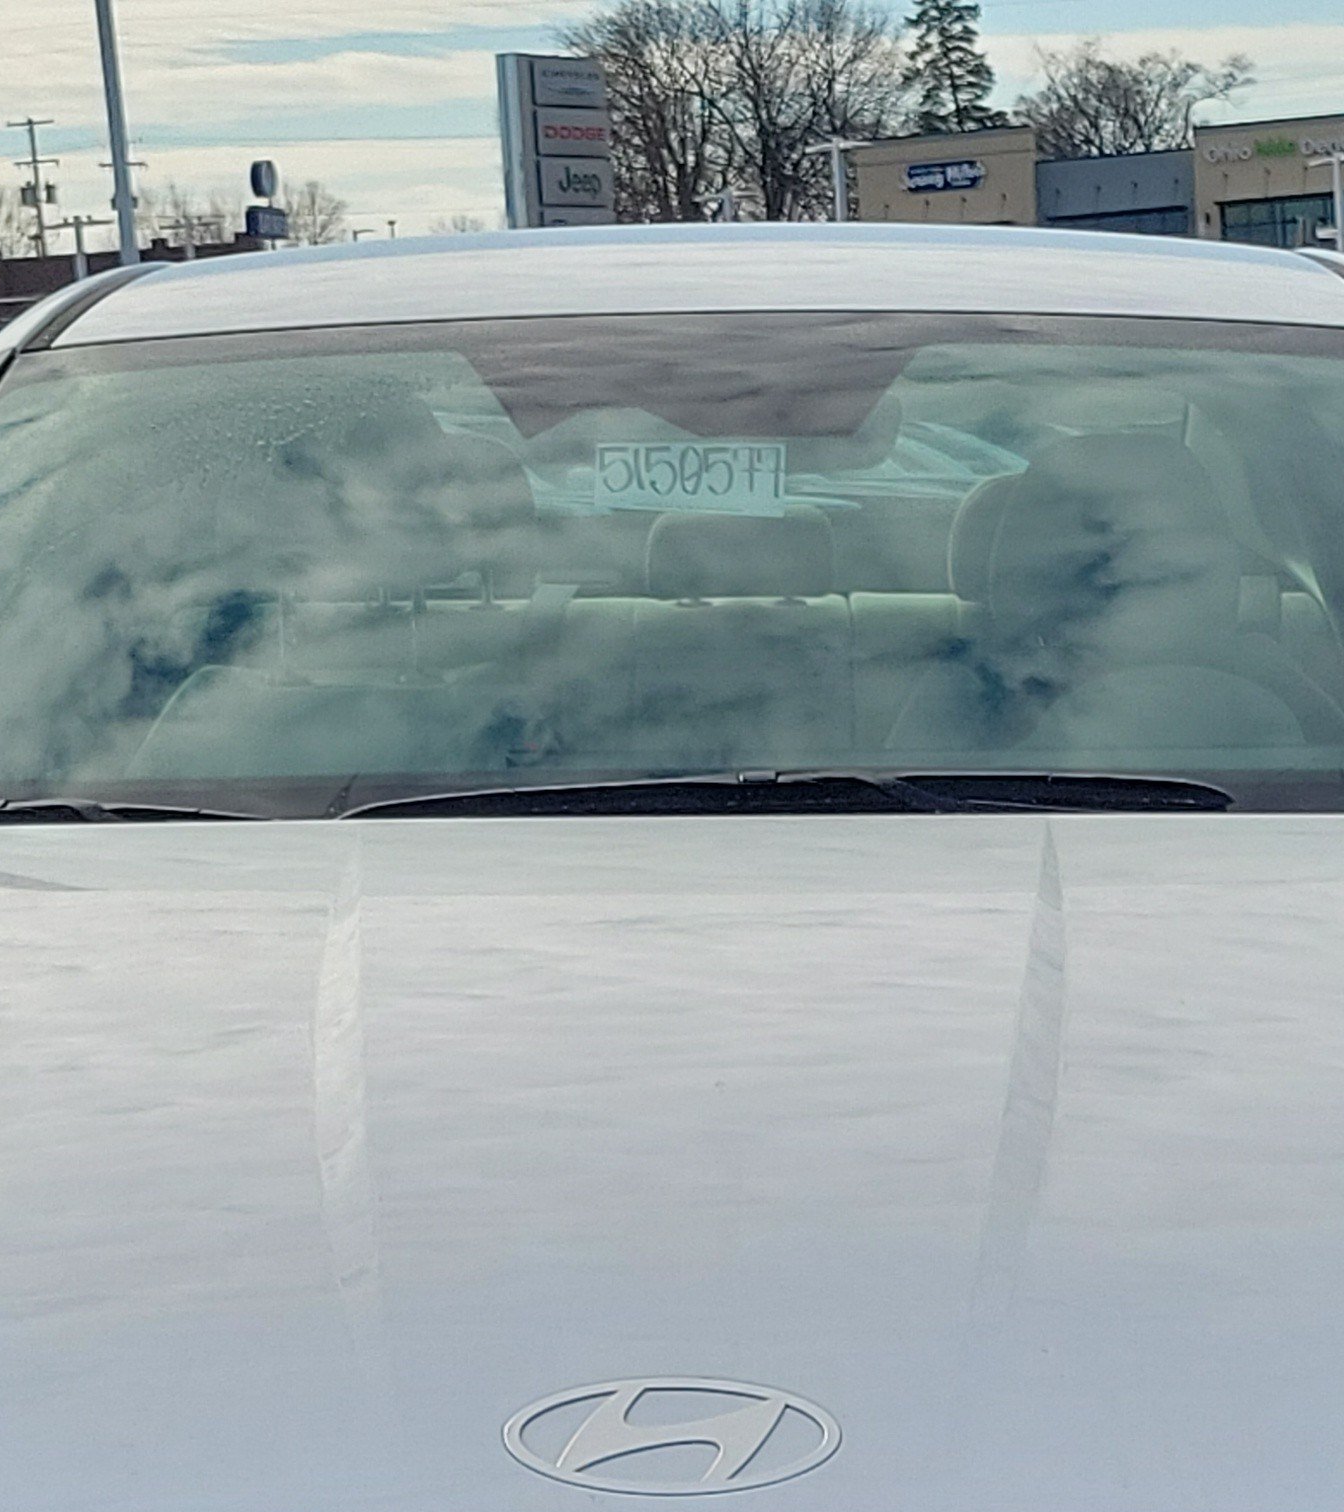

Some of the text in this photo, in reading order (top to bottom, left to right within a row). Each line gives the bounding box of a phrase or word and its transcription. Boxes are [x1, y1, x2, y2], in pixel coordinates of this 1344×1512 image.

[543, 124, 606, 141] DODGE
[559, 166, 602, 198] Jeep
[598, 445, 783, 498] 5150577
